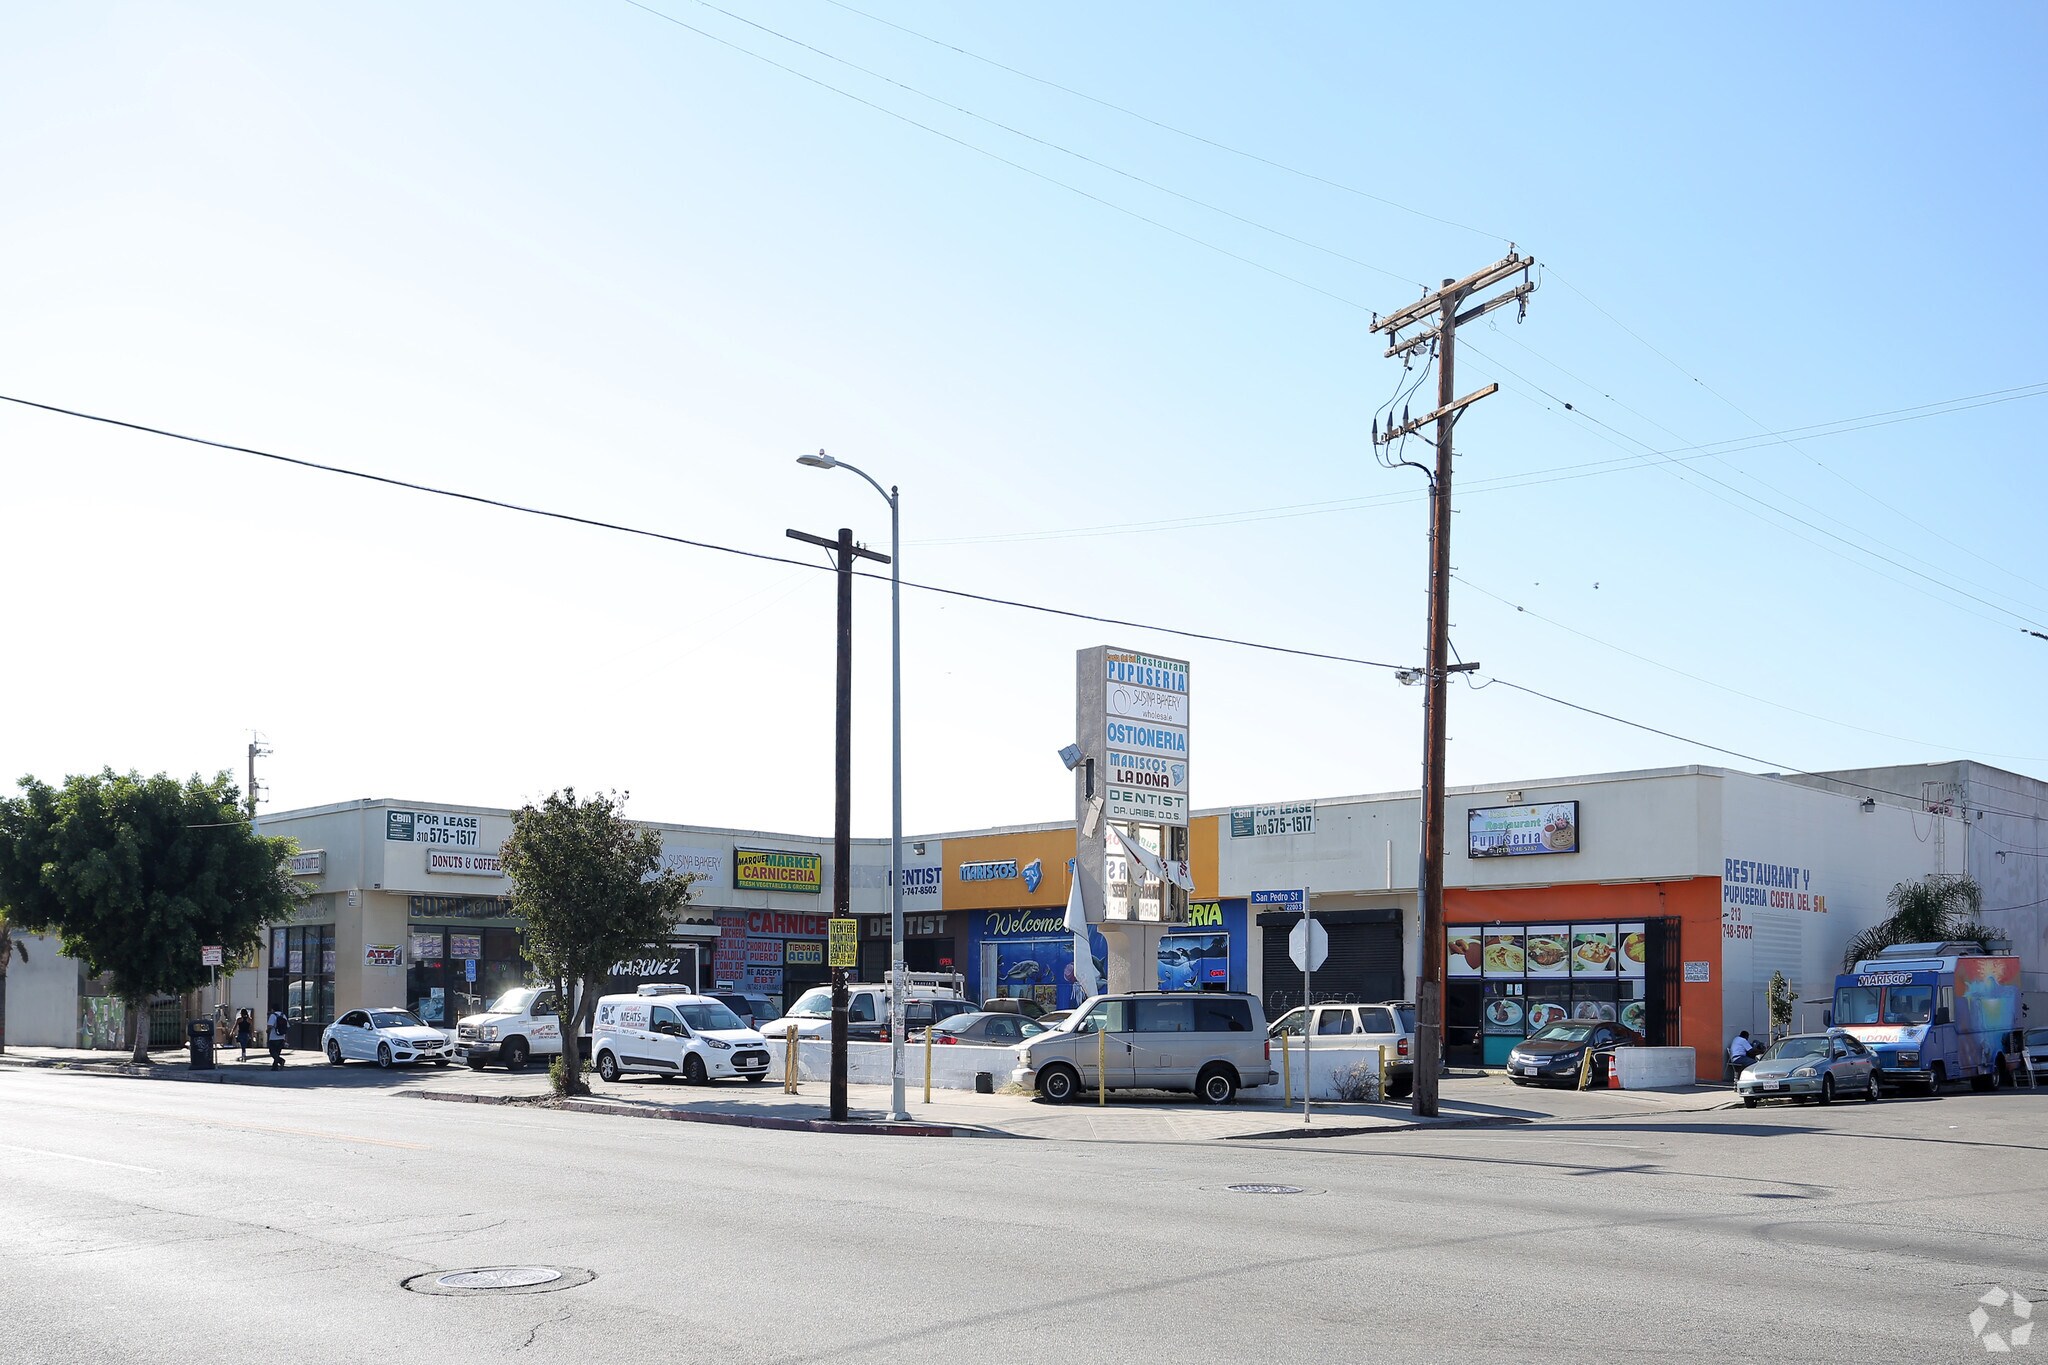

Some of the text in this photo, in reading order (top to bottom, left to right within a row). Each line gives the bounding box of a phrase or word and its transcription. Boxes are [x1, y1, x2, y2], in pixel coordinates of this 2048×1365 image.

[1137, 655, 1188, 674] Restaurant
[1109, 660, 1185, 692] PUPUSERIA
[1133, 690, 1181, 711] SUSINA BAKERY
[1142, 710, 1173, 722] wholesale
[1107, 722, 1185, 752] OSTIONERIA
[1110, 752, 1167, 773] MARISCOS
[1117, 769, 1169, 788] LA DOÑA
[1110, 790, 1184, 808] DENTIST
[1113, 806, 1182, 820] DR. URIBE, D.D.S.
[1234, 809, 1251, 819] CBM
[1256, 802, 1312, 816] FOR LEASE
[390, 813, 411, 824] CBM
[417, 814, 477, 828] FOR LEASE
[1257, 824, 1267, 835] 310
[1268, 816, 1312, 834] 575-1517
[1485, 818, 1542, 831] Restaurant
[416, 828, 477, 845] 310 575-1517
[1472, 831, 1541, 848] Pupuseria
[432, 855, 501, 871] DONUTS & COFFEE
[668, 854, 723, 871] SUSINA BAKERY
[738, 854, 817, 869] MARQUEZ MARKET
[743, 866, 816, 882] CARNICERIA
[959, 863, 1017, 882] MARISCOS
[1725, 858, 1810, 891] RESTAURANT Y
[756, 881, 787, 889] VEGETABLES
[1256, 892, 1298, 902] San Pedro St
[1724, 884, 1827, 913] PUPUSERIA COSTA DEL SOL
[1730, 907, 1741, 921] 213
[748, 911, 829, 936] CARNICE
[870, 915, 947, 937] DETIST
[721, 928, 746, 939] ANCHERA
[1722, 923, 1753, 940] 748-5787
[747, 941, 782, 952] CHORIZO DE
[788, 943, 820, 952] TIENDA DE
[367, 950, 395, 959] ATM
[749, 952, 778, 962] PUERCO
[788, 951, 819, 962] AGUA
[607, 959, 680, 977] MARQUEZ
[735, 961, 744, 971] DE
[756, 968, 782, 977] ACCEPT
[716, 970, 744, 980] PUERCO
[1857, 973, 1913, 987] MARISCOS
[620, 1012, 641, 1022] MEATS
